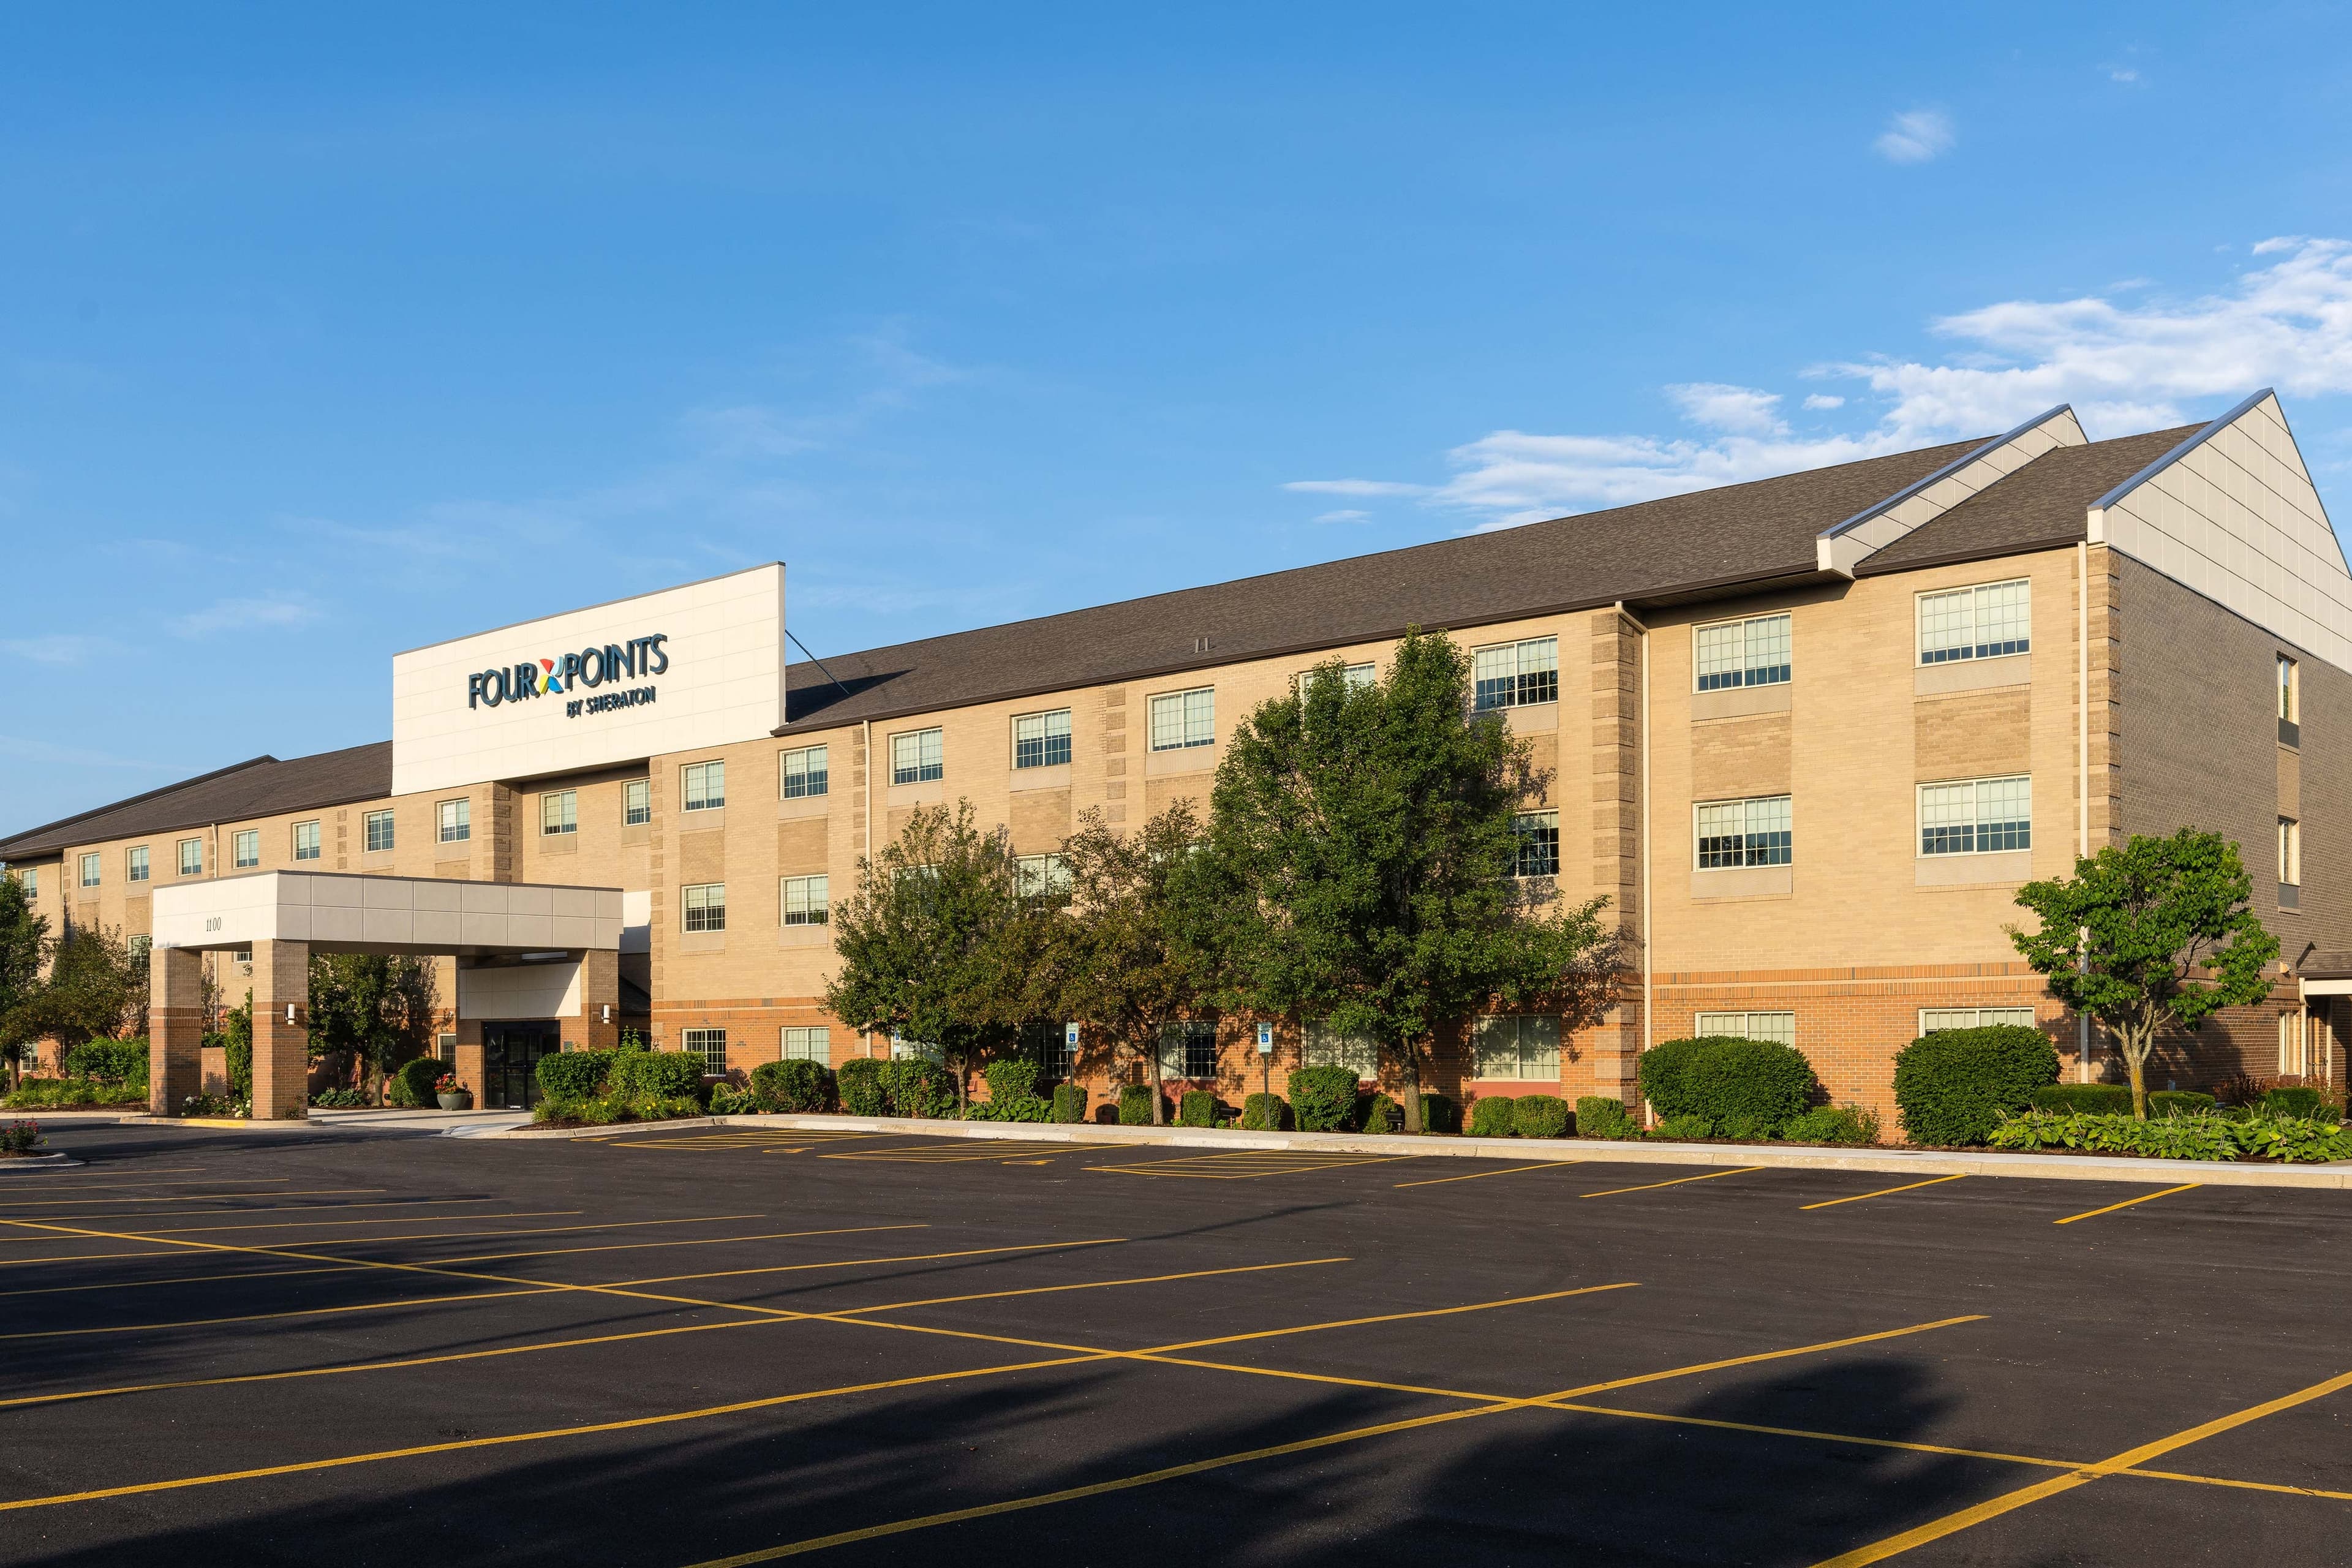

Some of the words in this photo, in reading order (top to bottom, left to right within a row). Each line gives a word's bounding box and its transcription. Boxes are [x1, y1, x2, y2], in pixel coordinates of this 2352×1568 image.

[469, 663, 540, 710] FOUR
[565, 633, 668, 692] POINTS
[567, 699, 584, 718] BY
[586, 685, 656, 714] SHERATON
[206, 916, 221, 932] 1100
